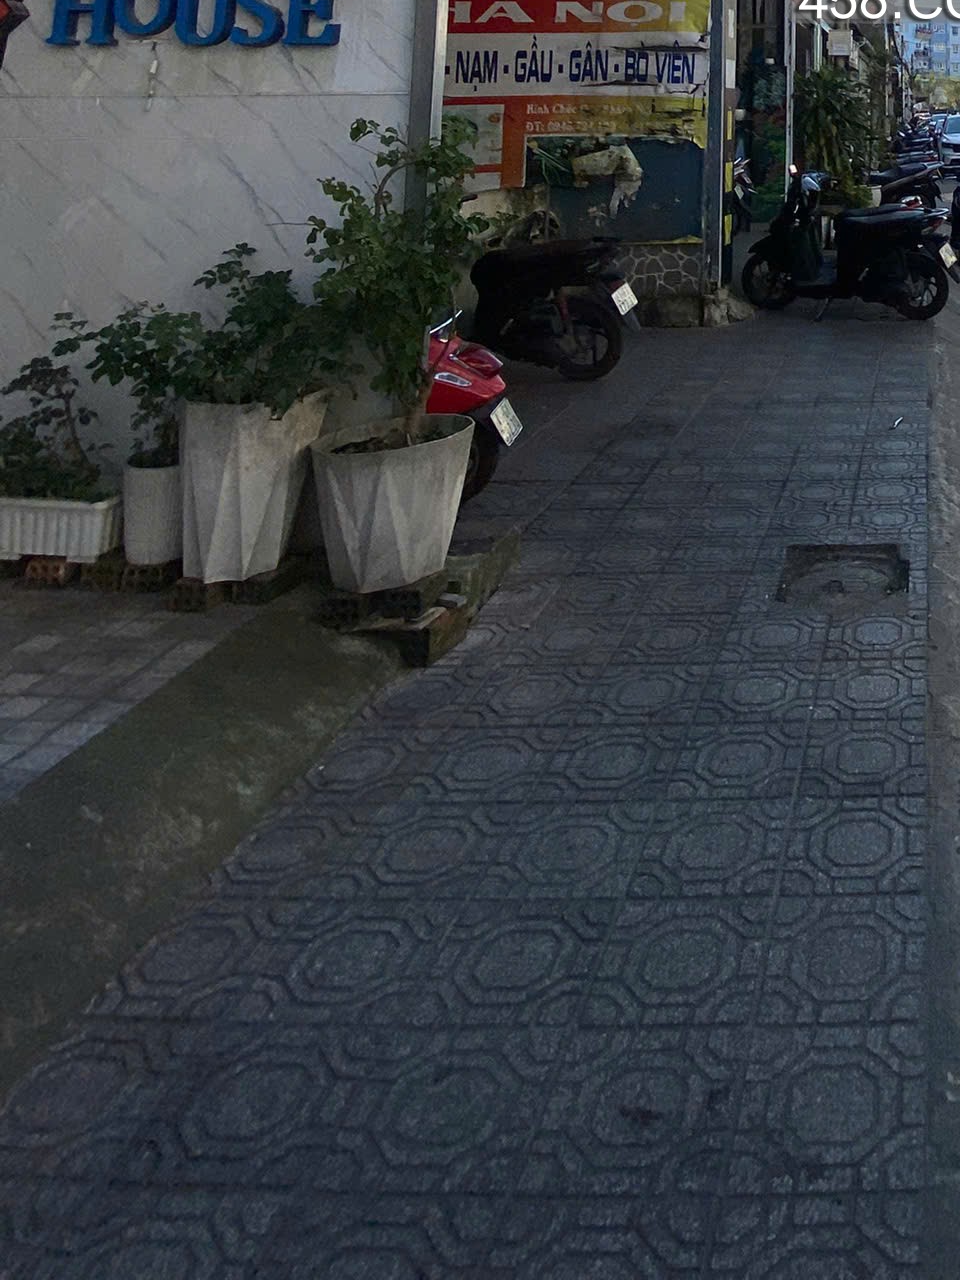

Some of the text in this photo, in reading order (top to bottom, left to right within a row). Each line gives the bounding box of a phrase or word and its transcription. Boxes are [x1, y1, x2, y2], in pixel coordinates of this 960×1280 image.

[455, 51, 498, 92] NẠM
[515, 35, 553, 83] GẦU
[569, 40, 608, 83] GÂN
[656, 39, 695, 84] VIÊN
